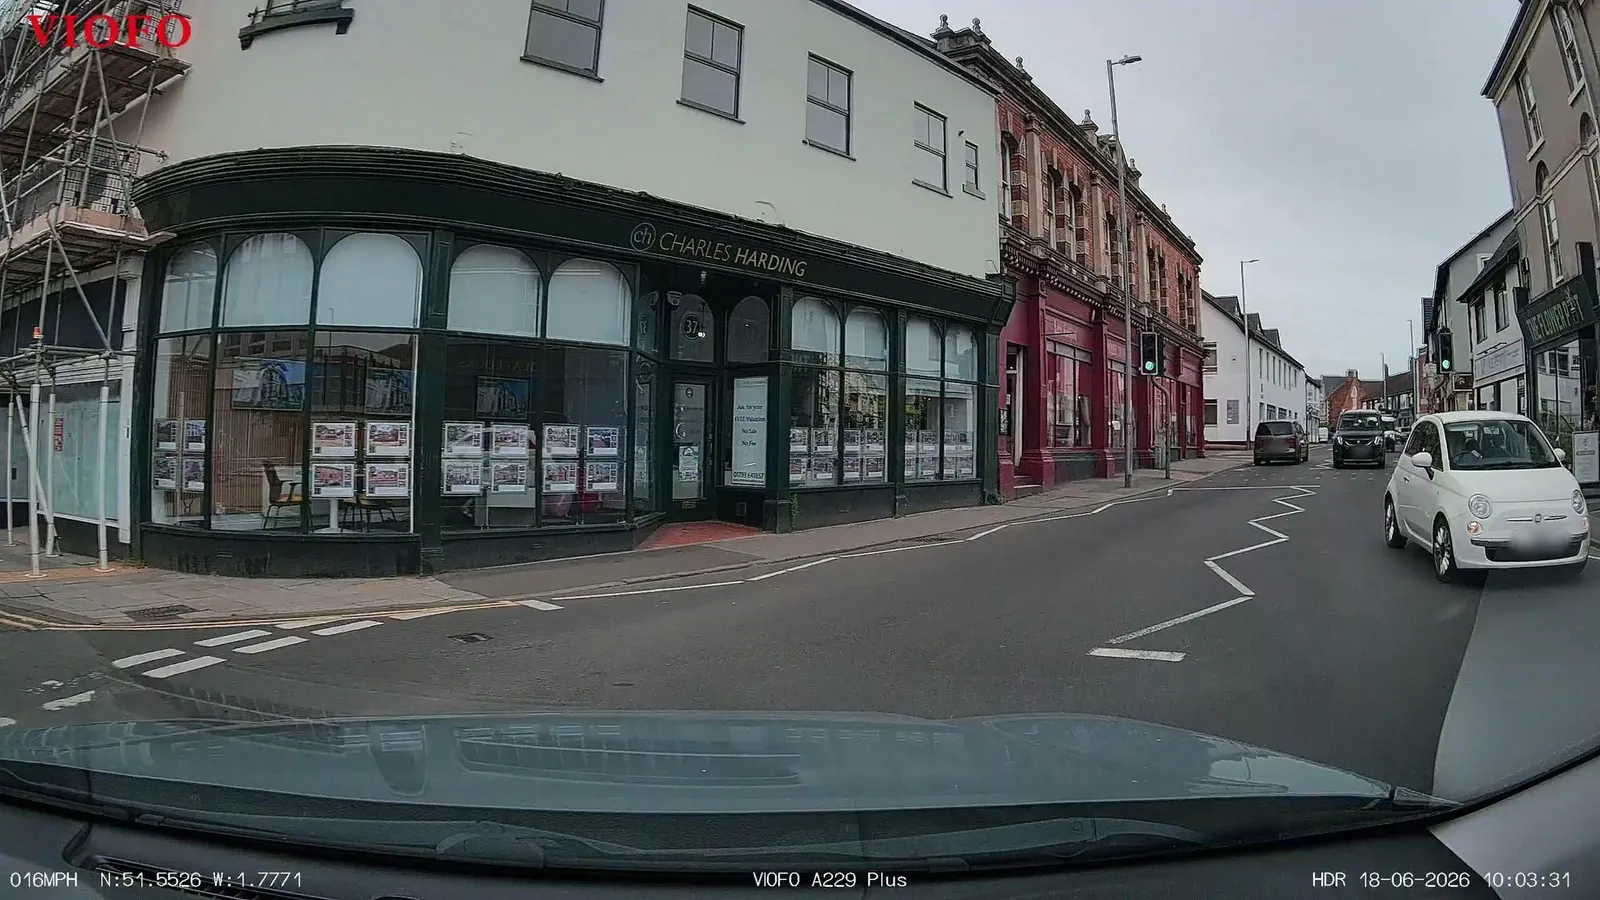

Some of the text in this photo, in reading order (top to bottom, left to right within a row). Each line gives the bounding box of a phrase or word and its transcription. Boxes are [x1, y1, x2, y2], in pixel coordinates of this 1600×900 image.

[633, 227, 651, 245] ch
[660, 232, 807, 277] CHARLES HARDING
[686, 319, 698, 334] 37
